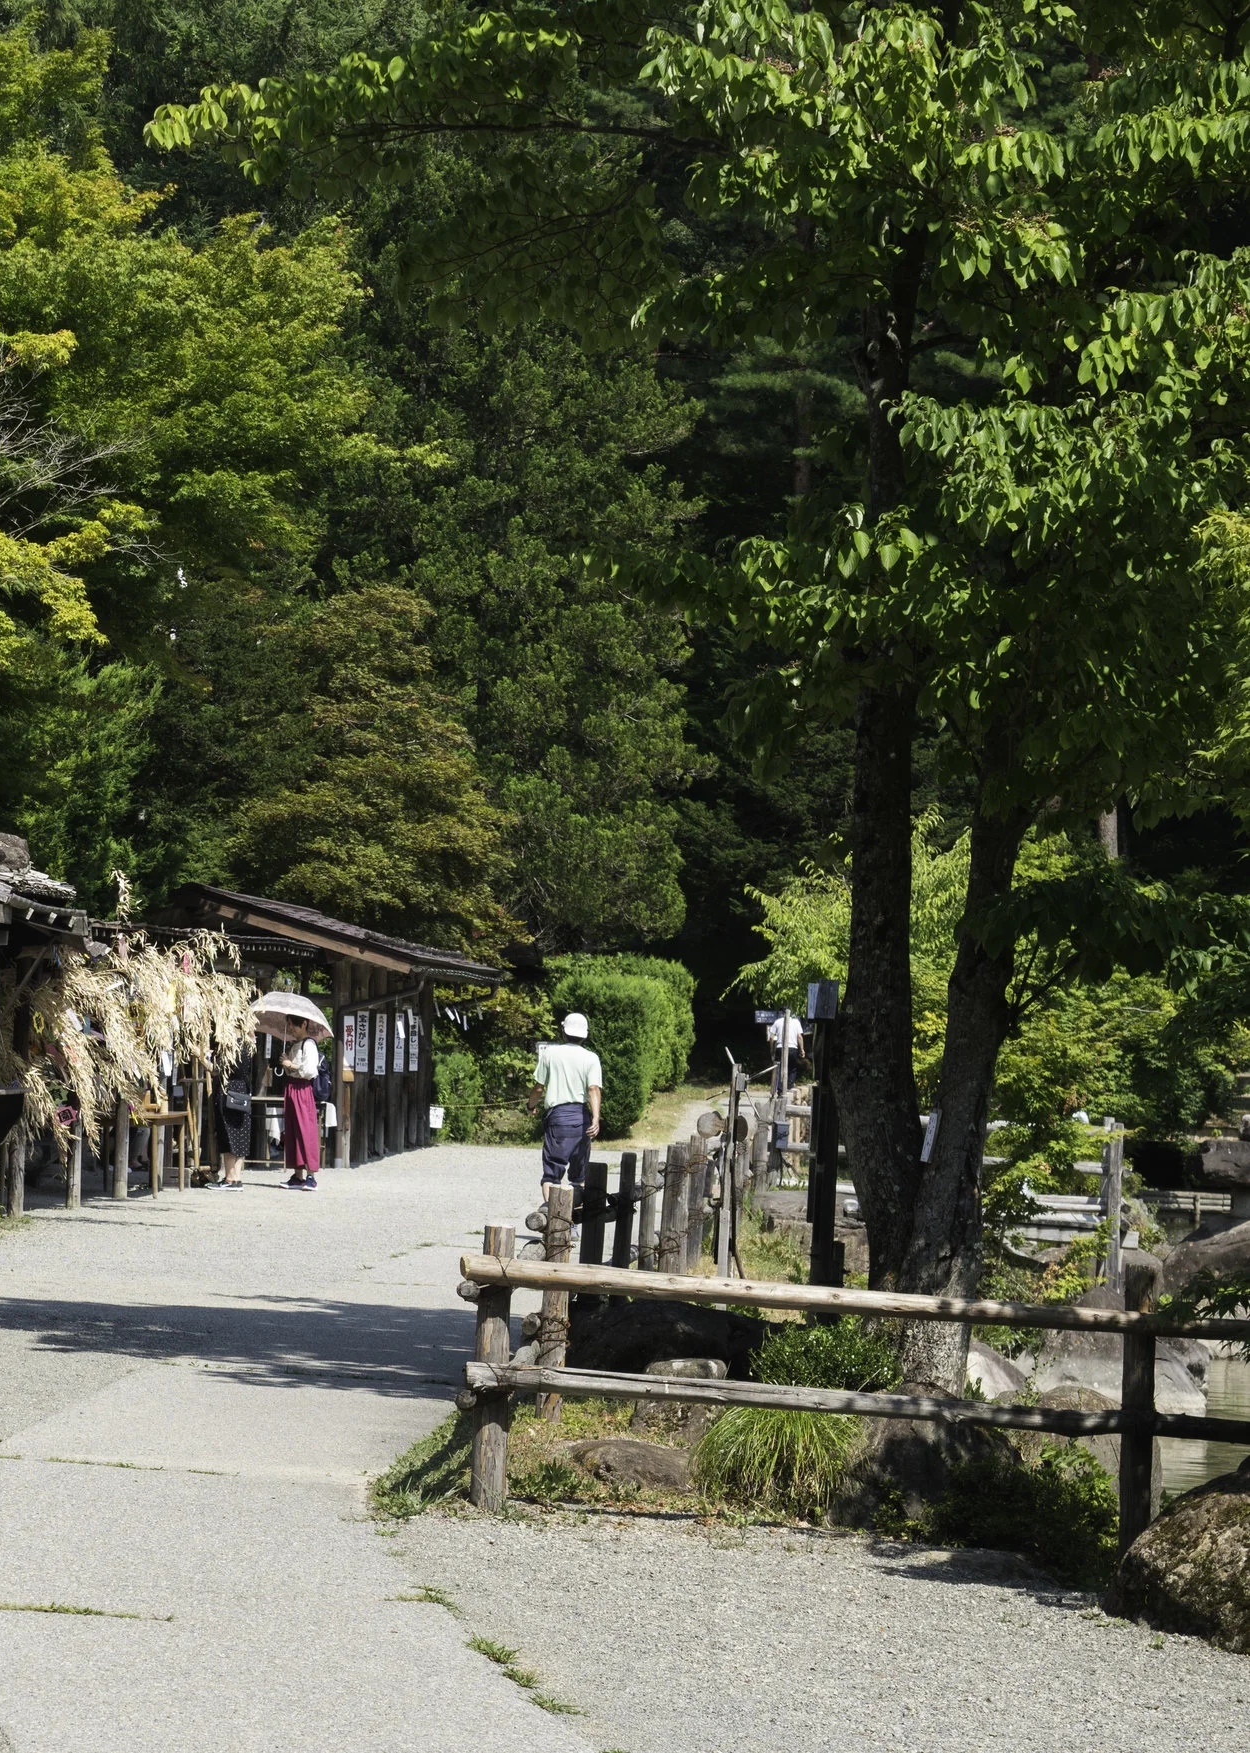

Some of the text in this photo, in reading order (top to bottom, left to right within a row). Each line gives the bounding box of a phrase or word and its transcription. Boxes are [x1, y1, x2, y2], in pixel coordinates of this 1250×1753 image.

[345, 1024, 354, 1052] 受付
[358, 1015, 367, 1048] 宝さがし
